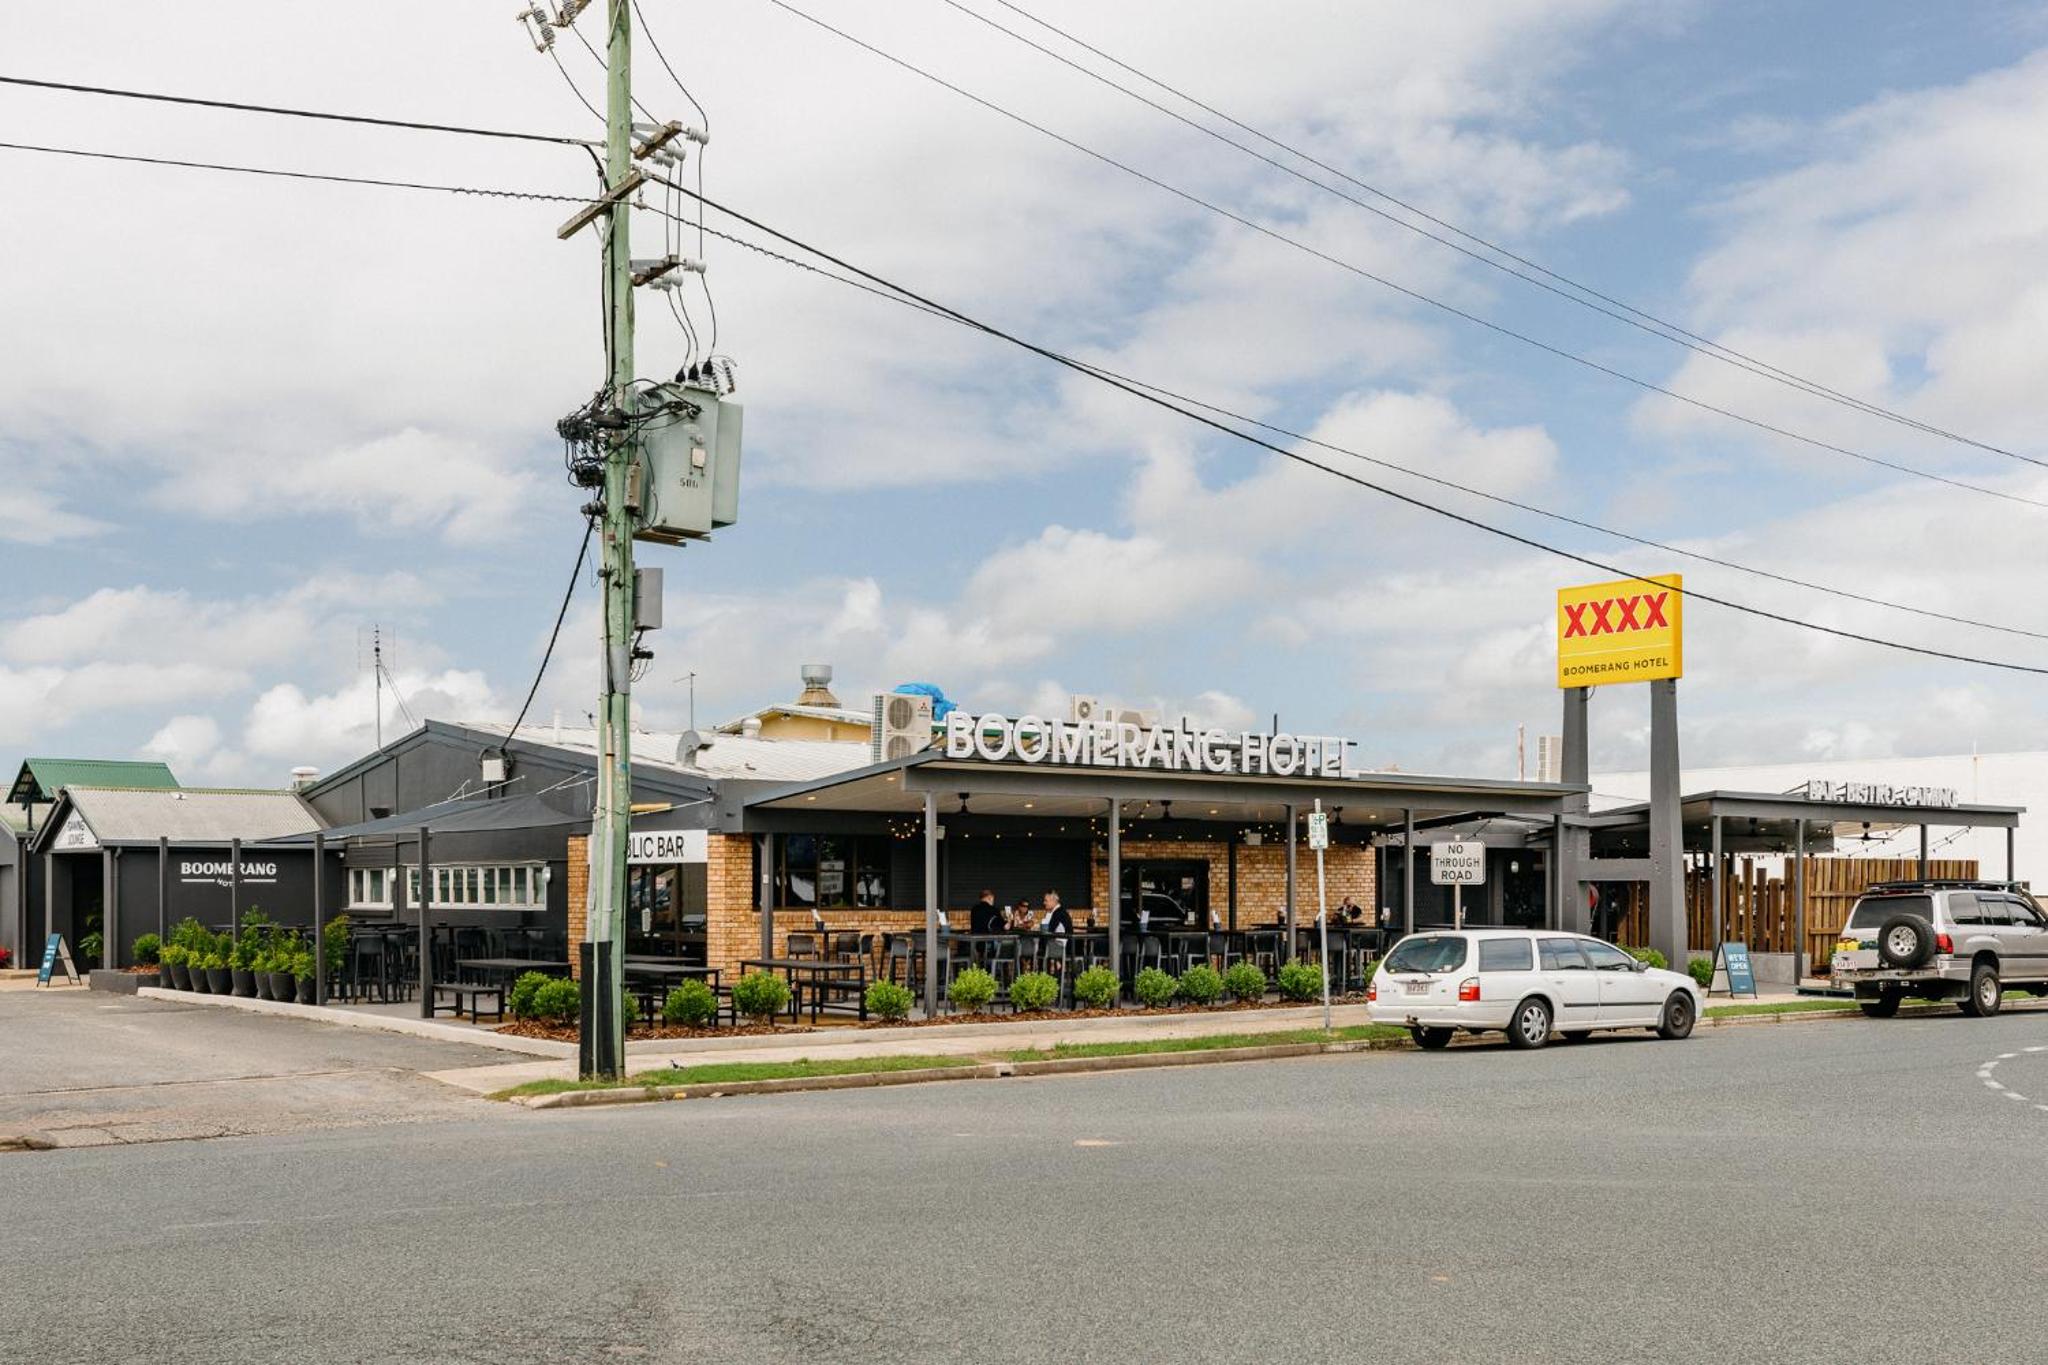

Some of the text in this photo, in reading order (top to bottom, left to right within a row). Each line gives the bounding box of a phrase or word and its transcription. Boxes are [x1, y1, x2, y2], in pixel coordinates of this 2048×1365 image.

[1563, 592, 1669, 638] XXXX
[1563, 657, 1669, 676] BOOMERANG HOTEL
[946, 711, 1360, 778] BOOMERANG HOTEL
[657, 835, 685, 858] BAR
[1448, 844, 1463, 854] NO
[181, 862, 277, 875] BOOMERANG
[1435, 857, 1480, 868] THROUGH
[1441, 870, 1473, 880] ROAD
[217, 878, 243, 887] HOT
